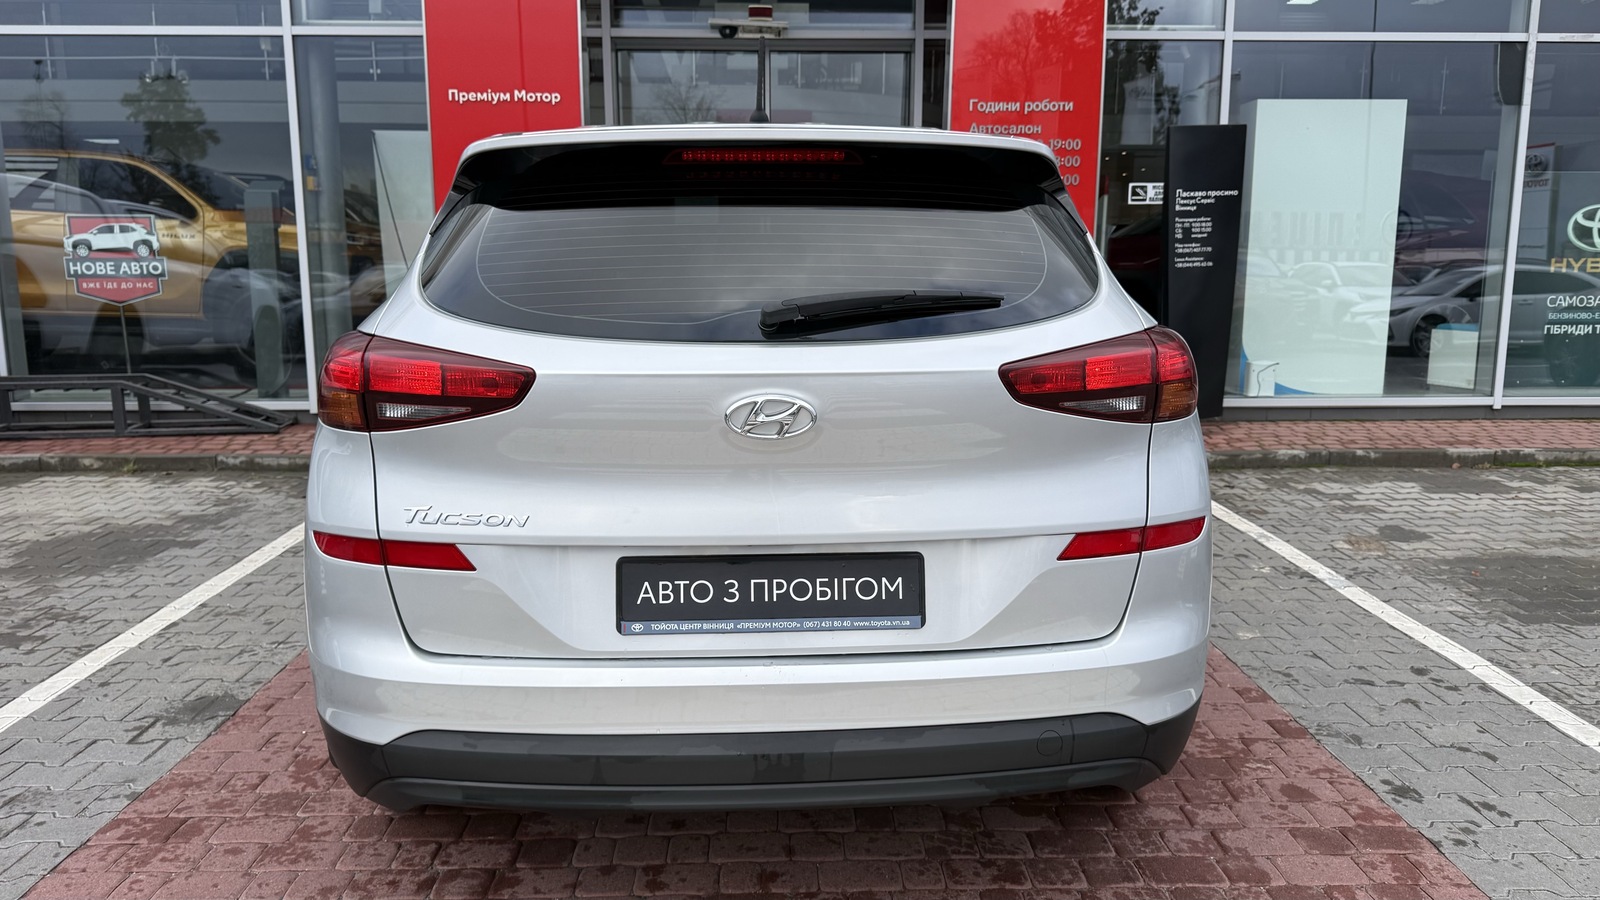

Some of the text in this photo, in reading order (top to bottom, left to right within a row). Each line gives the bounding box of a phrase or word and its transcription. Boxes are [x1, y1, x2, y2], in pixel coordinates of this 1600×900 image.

[447, 88, 561, 105] Преміум Мотор
[969, 98, 1074, 115] Години роботи
[969, 122, 1042, 134] Автосалон
[1207, 189, 1239, 198] просимо
[69, 261, 162, 276] НОВЕ АВТО
[82, 281, 101, 289] ВЖЕ
[120, 281, 133, 289] ДО
[136, 281, 154, 289] НАС
[1544, 324, 1593, 336] ГІБРИДИ
[636, 576, 903, 605] АВТО З ПРОБІГОМ
[650, 622, 679, 631] ТОЙОТА
[679, 623, 702, 631] ЦЕНТР
[702, 622, 734, 630] ВІННИЦЯ
[803, 620, 820, 628] (067)
[853, 619, 910, 627] www.toyota.vn.ua
